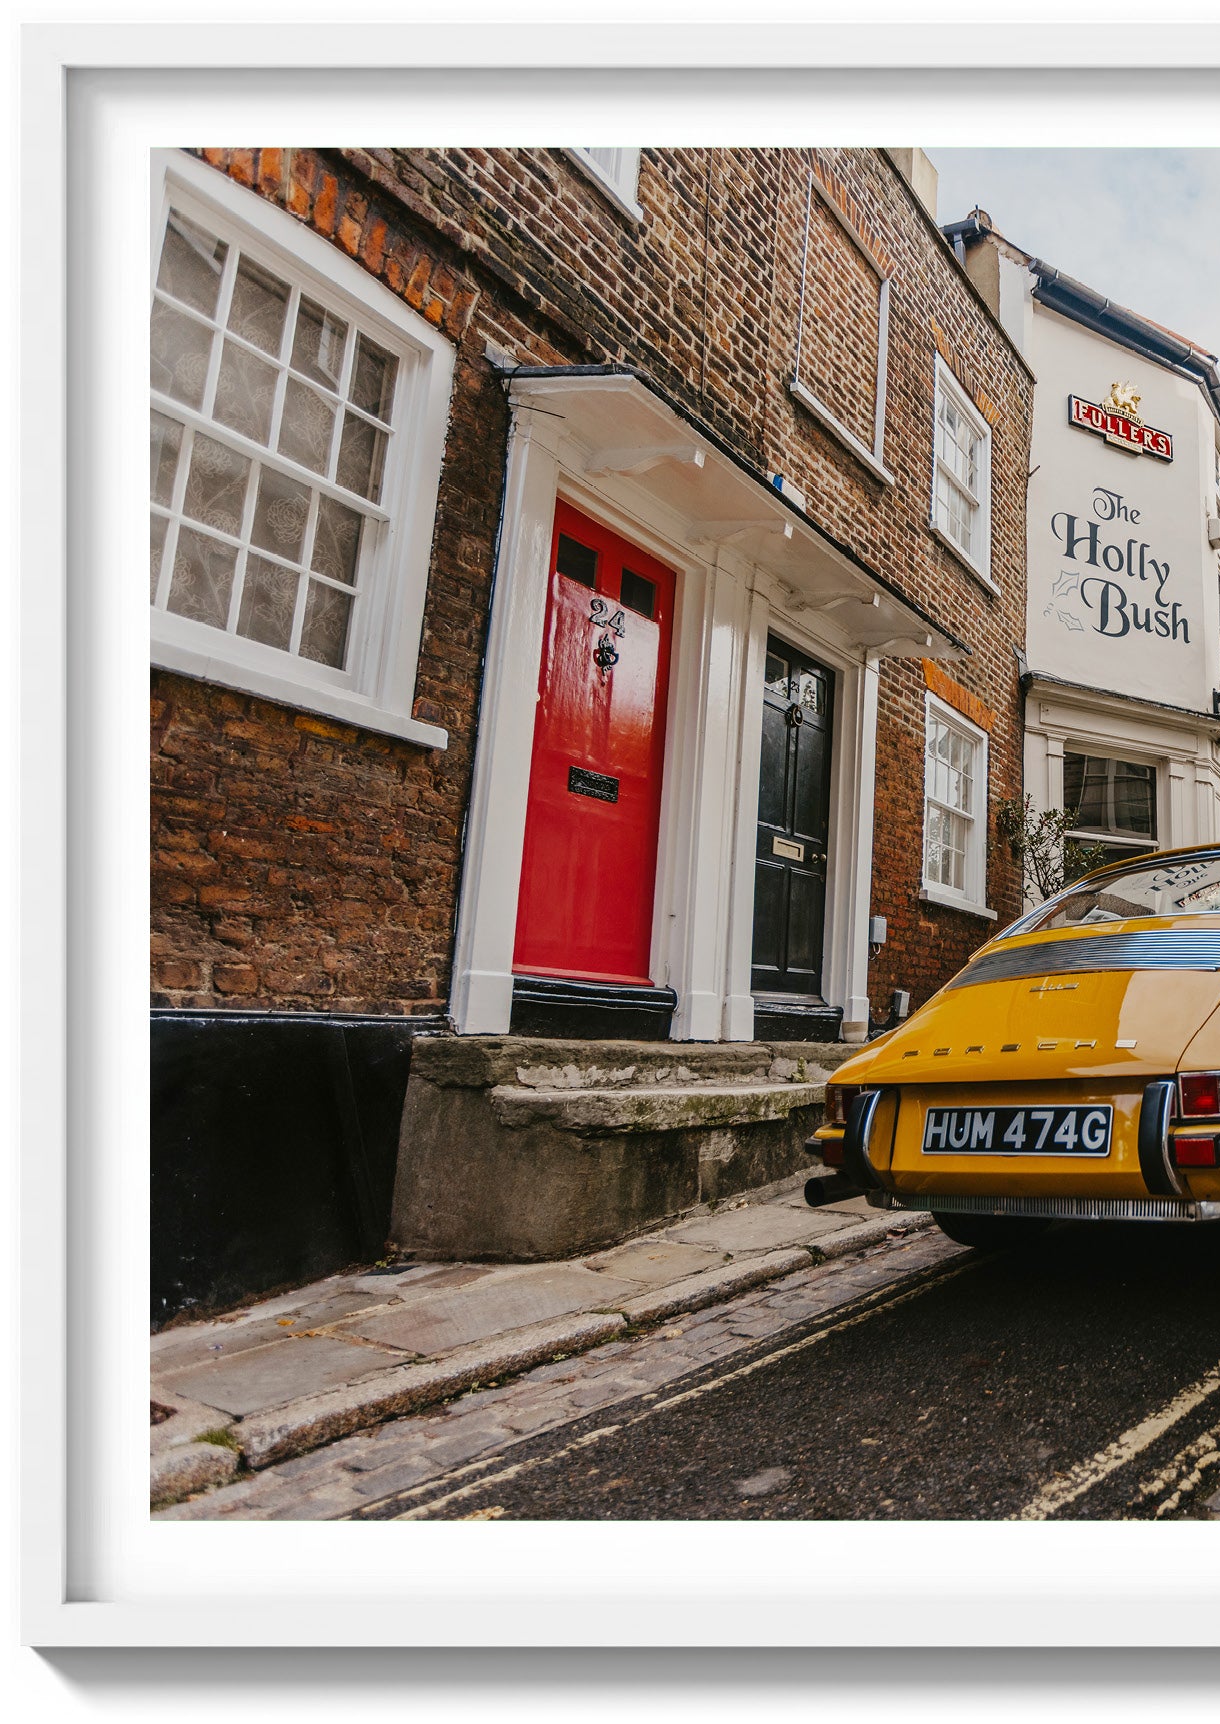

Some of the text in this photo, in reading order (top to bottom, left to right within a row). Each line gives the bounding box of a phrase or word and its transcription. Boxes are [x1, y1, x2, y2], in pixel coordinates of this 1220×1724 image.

[1092, 487, 1141, 525] The
[1051, 512, 1170, 607] Holly
[589, 598, 625, 638] 24
[1080, 577, 1191, 644] Bush
[902, 1039, 1138, 1060] PORSCHE
[925, 1110, 1107, 1150] HUM 474G
